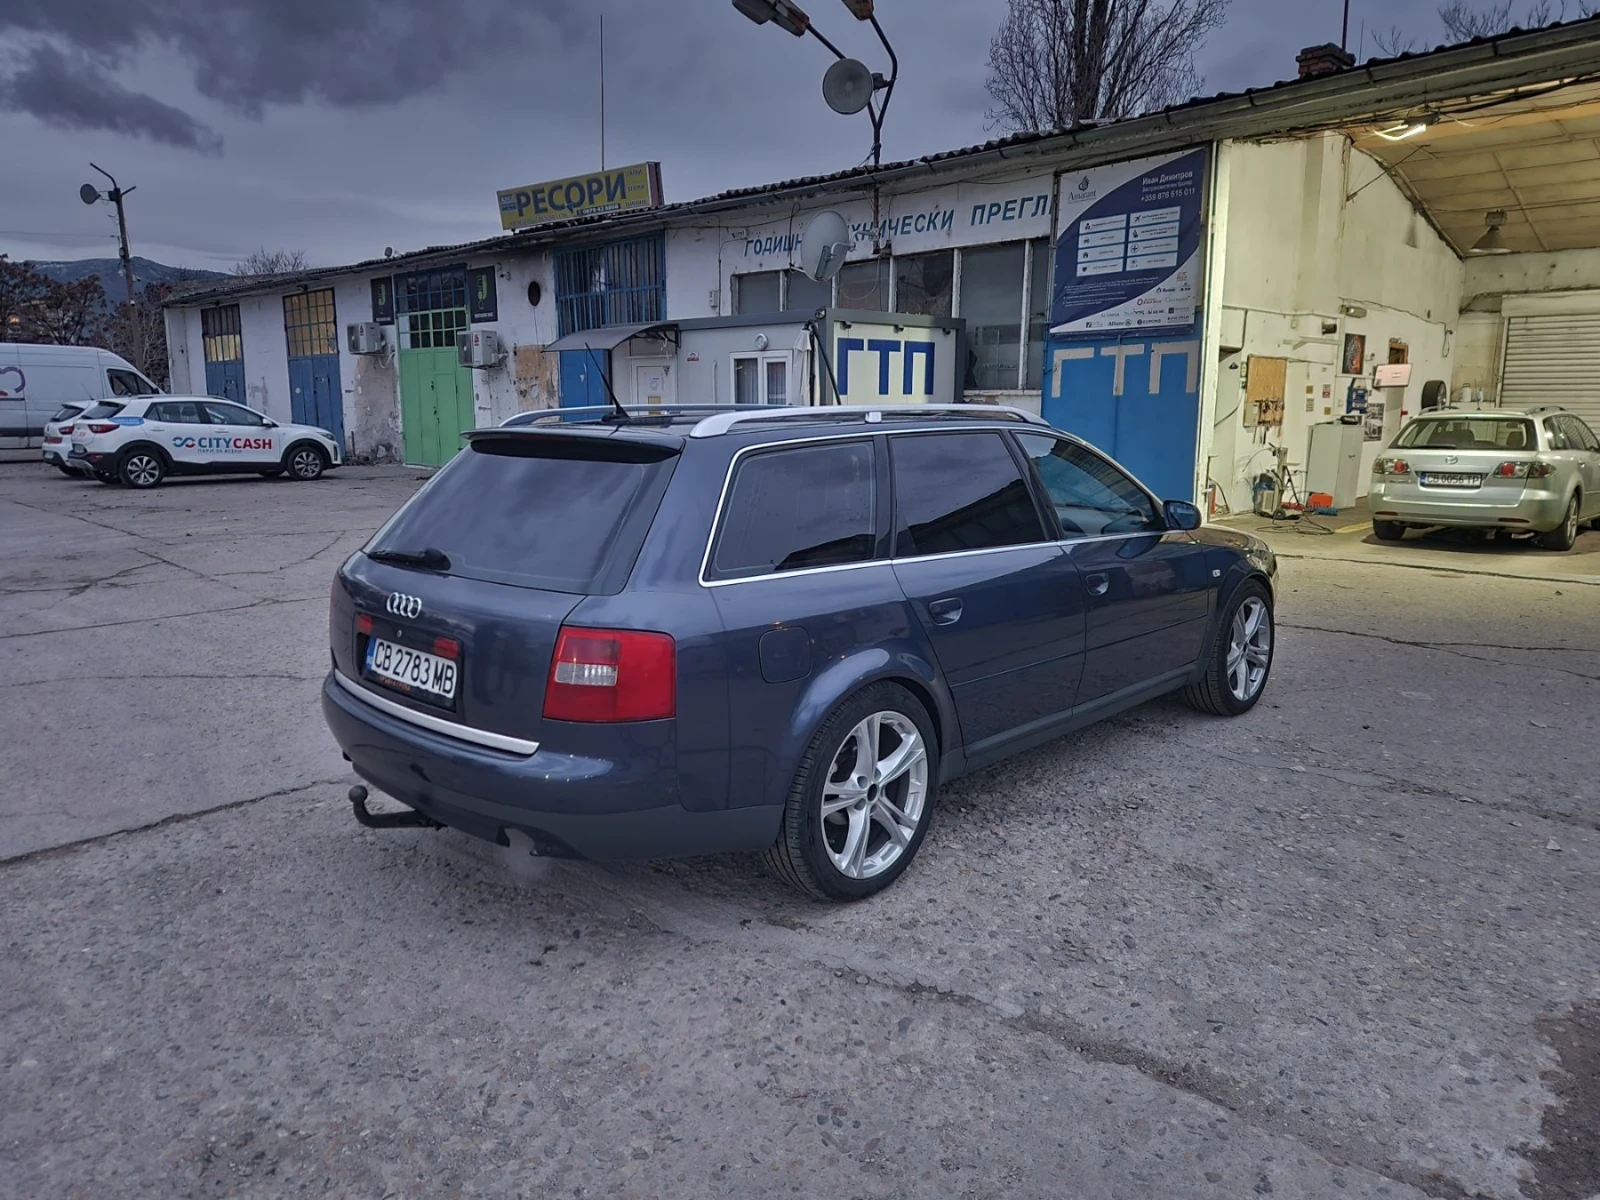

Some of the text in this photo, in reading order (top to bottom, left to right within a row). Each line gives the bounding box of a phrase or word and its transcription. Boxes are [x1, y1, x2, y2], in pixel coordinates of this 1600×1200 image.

[516, 174, 626, 216] РЕСОРИ
[1141, 193, 1157, 202] +359
[1159, 170, 1193, 183] Димитров
[837, 337, 935, 395] ГТП
[1051, 340, 1200, 398] ГТП
[375, 642, 392, 672] CB
[393, 649, 431, 685] 2783
[431, 661, 455, 694] MB
